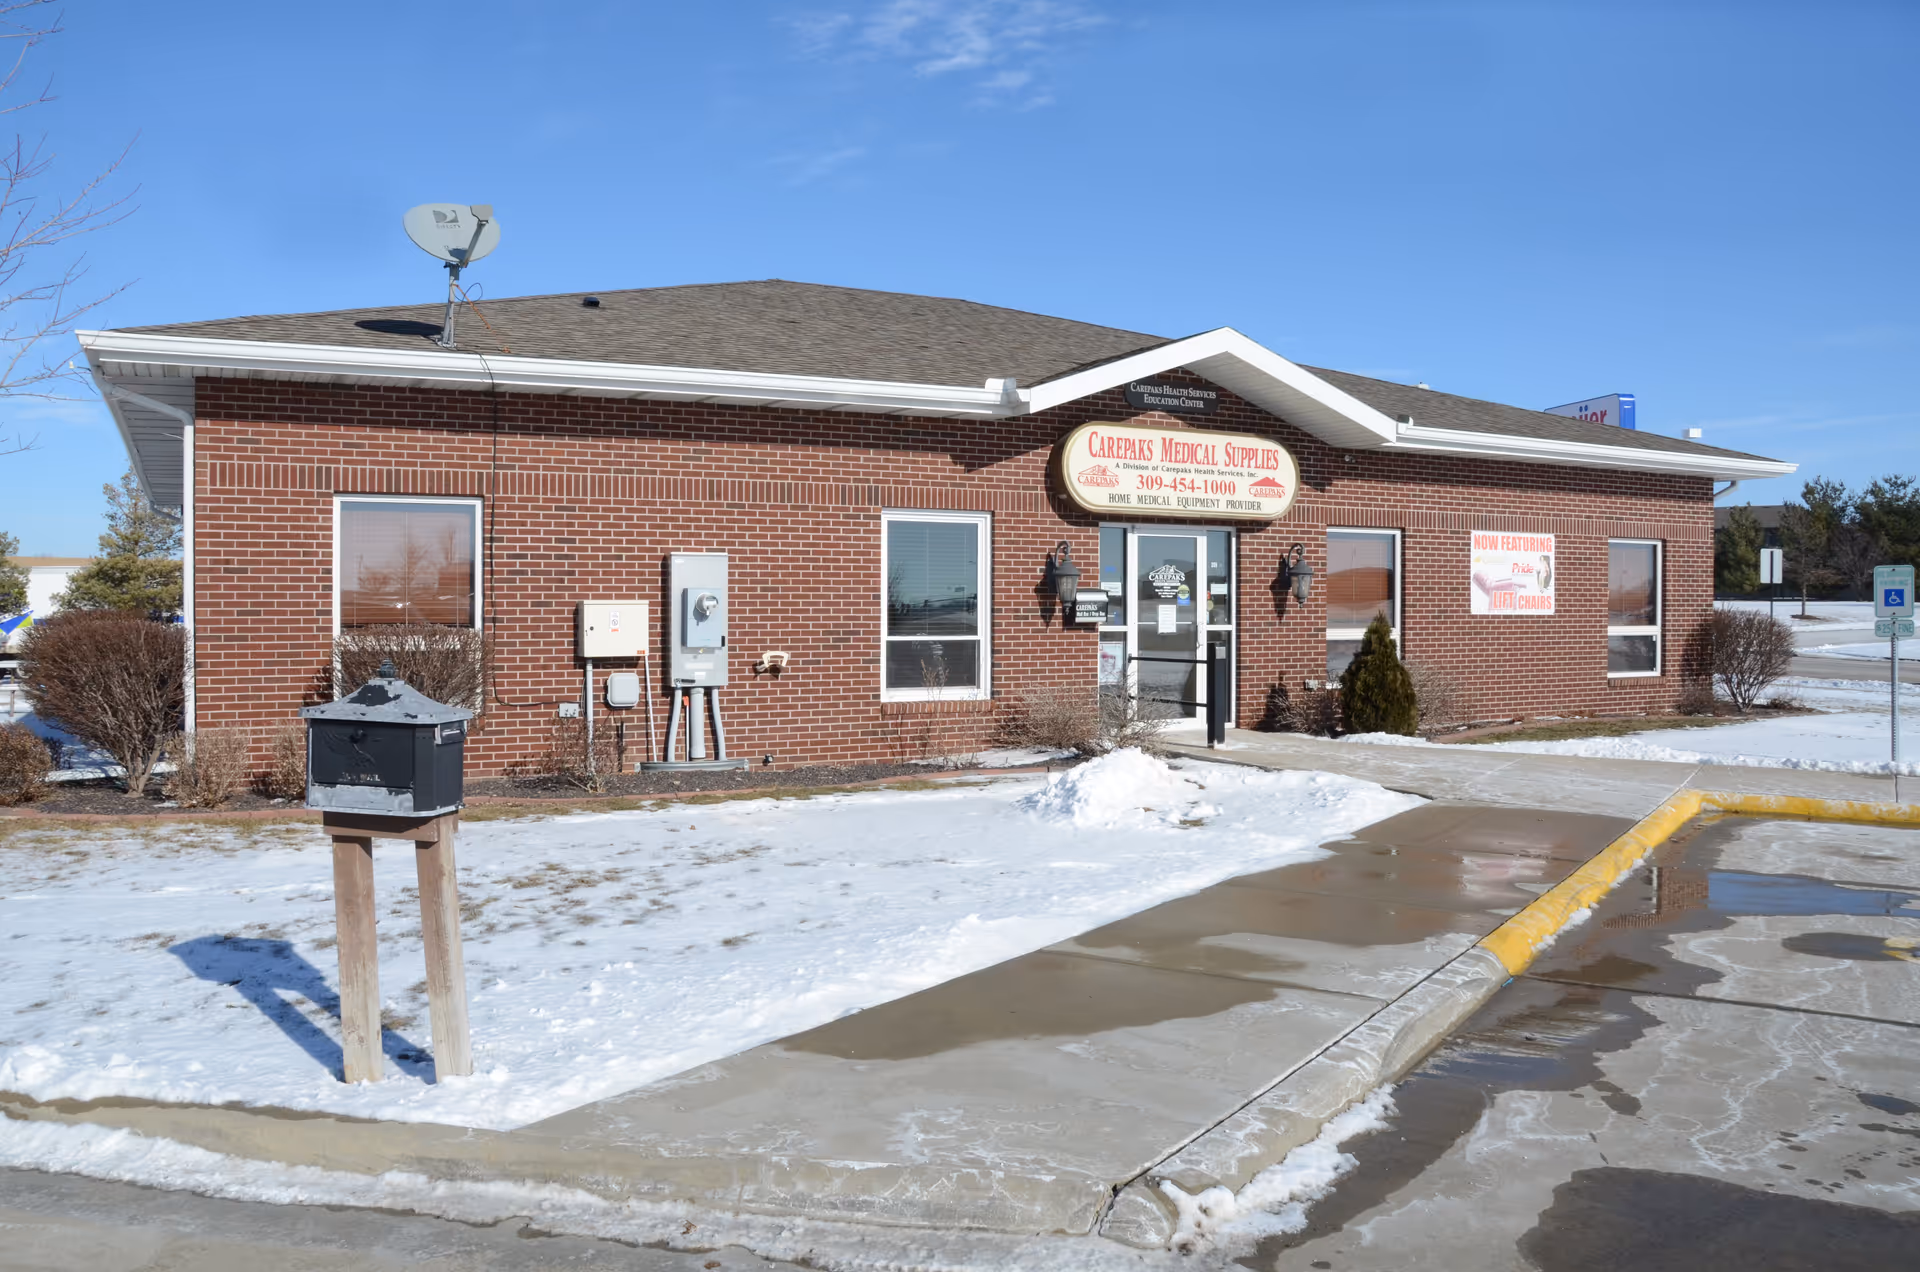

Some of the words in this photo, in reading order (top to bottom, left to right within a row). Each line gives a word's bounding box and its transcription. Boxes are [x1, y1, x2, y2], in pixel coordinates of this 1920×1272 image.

[1130, 382, 1163, 395] CAREPAKS
[1163, 385, 1188, 397] HEALTH
[1188, 387, 1217, 399] SERVICES
[1143, 394, 1180, 406] EDUCATION
[1180, 397, 1204, 408] CENTER
[1088, 431, 1153, 462] CAREPAKS
[1160, 436, 1219, 466] MEDICAL
[1224, 441, 1279, 471] SUPPLIES
[1122, 462, 1149, 471] Division
[1151, 464, 1159, 472] of
[1161, 465, 1192, 474] Carepaks
[1194, 467, 1215, 476] Health
[1077, 475, 1120, 487] CAREPAKS
[1136, 474, 1236, 496] 309-454-1000
[1248, 487, 1286, 497] CAREPAKS
[1108, 493, 1132, 504] HOME
[1137, 495, 1172, 506] MEDICAL
[1177, 496, 1221, 509] EQUIPMENT
[1226, 499, 1262, 511] PROVIDER
[1474, 534, 1499, 551] NOW
[1501, 535, 1553, 553] FEATURING
[1512, 562, 1535, 574] Pride
[1493, 591, 1515, 609] LIFT
[1518, 595, 1552, 610] CHAIRS
